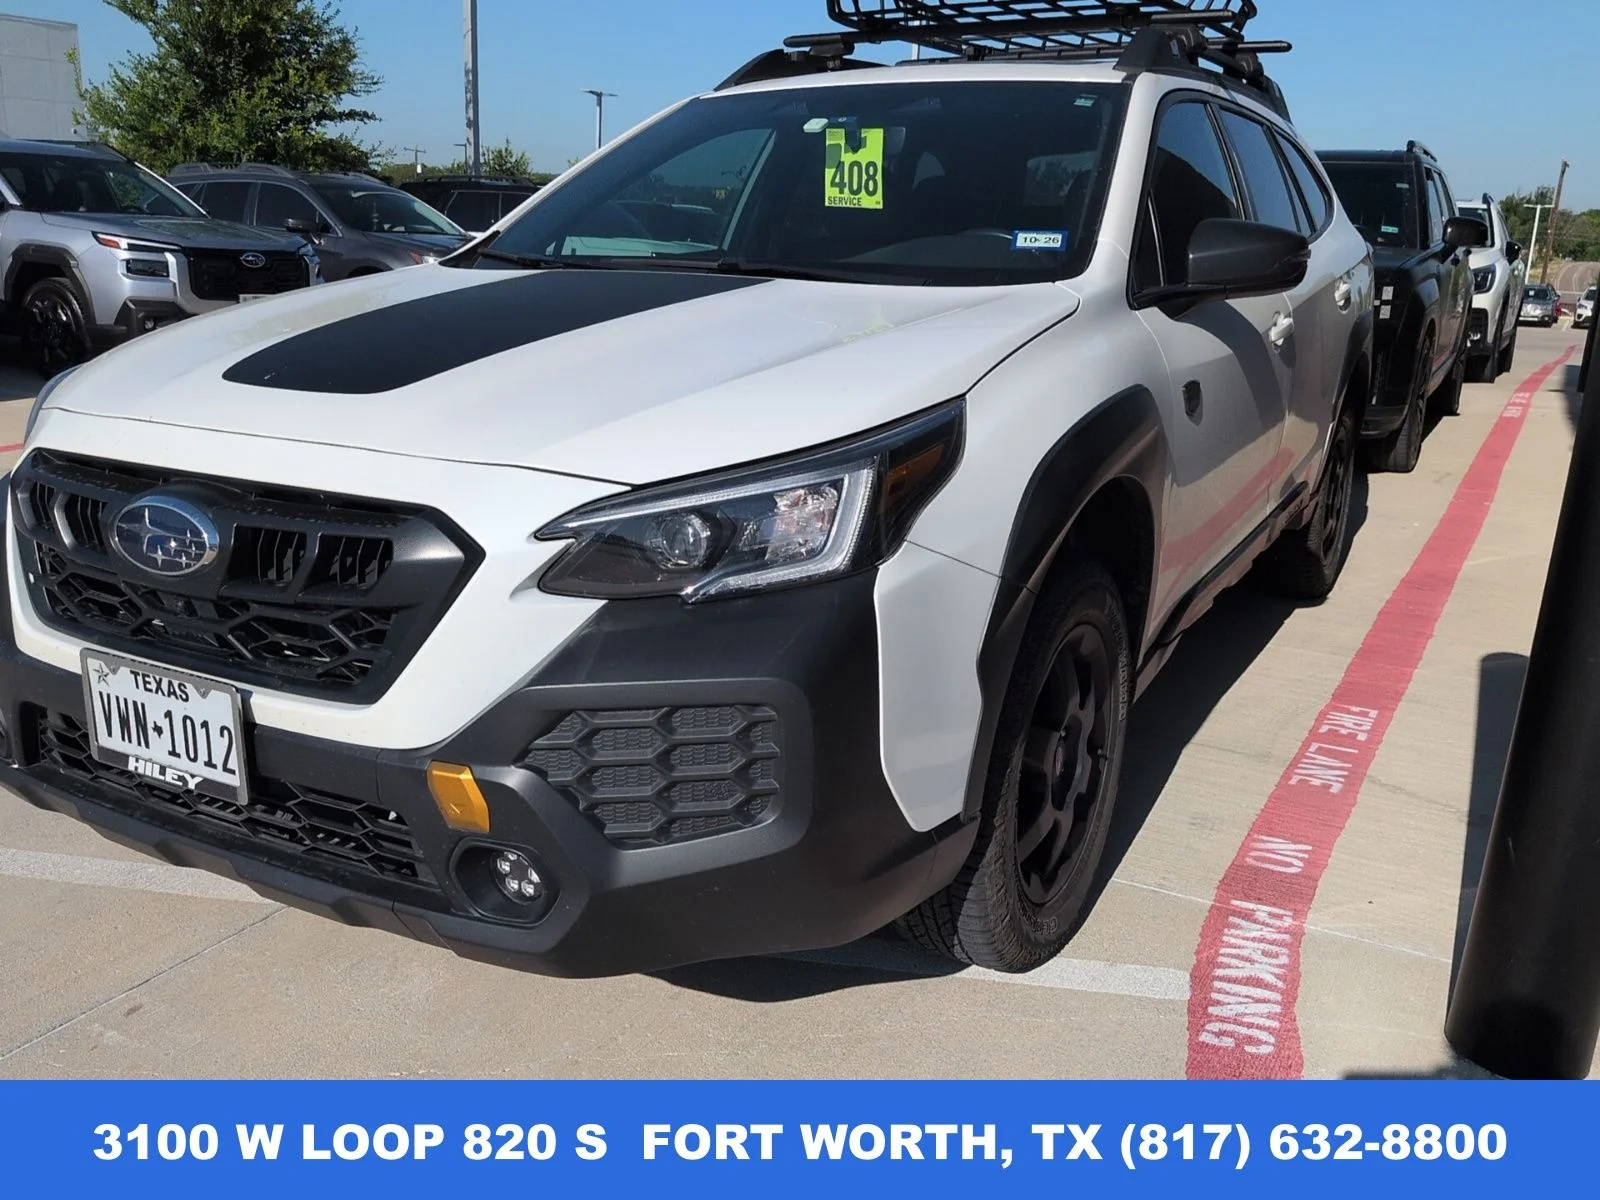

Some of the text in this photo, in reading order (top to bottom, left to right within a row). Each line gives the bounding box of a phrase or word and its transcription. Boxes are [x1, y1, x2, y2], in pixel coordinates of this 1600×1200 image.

[830, 160, 878, 197] 408
[827, 196, 862, 206] SERVICE
[129, 669, 190, 702] TEXAS
[1288, 703, 1379, 794] FIRE LANE
[127, 756, 203, 790] HILEY
[1199, 834, 1313, 1055] NO PARKING
